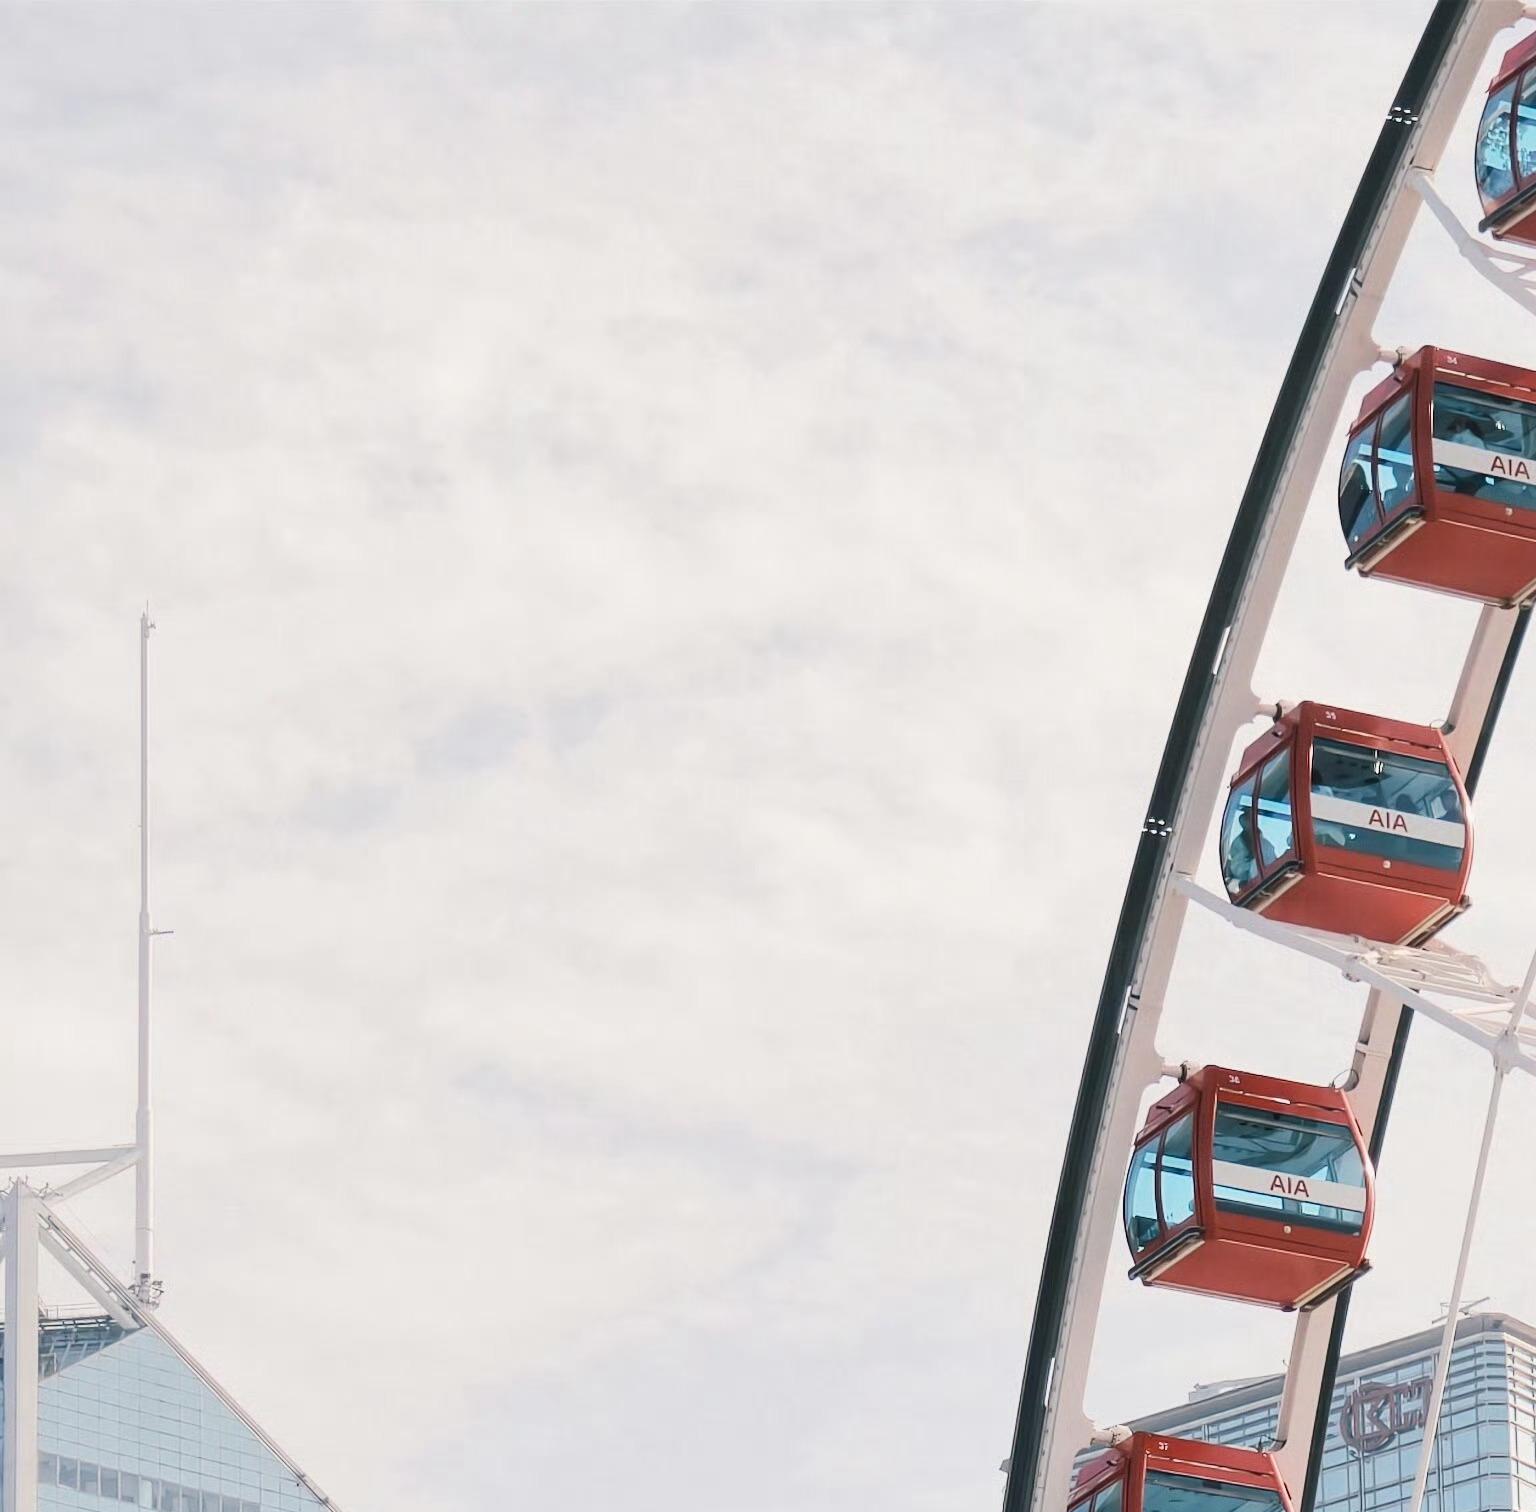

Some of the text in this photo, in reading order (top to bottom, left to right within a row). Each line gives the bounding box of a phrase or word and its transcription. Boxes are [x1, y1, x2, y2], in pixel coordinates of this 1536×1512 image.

[1490, 456, 1530, 480] AIA
[1368, 809, 1408, 833] AIA
[1269, 1174, 1310, 1197] AIA
